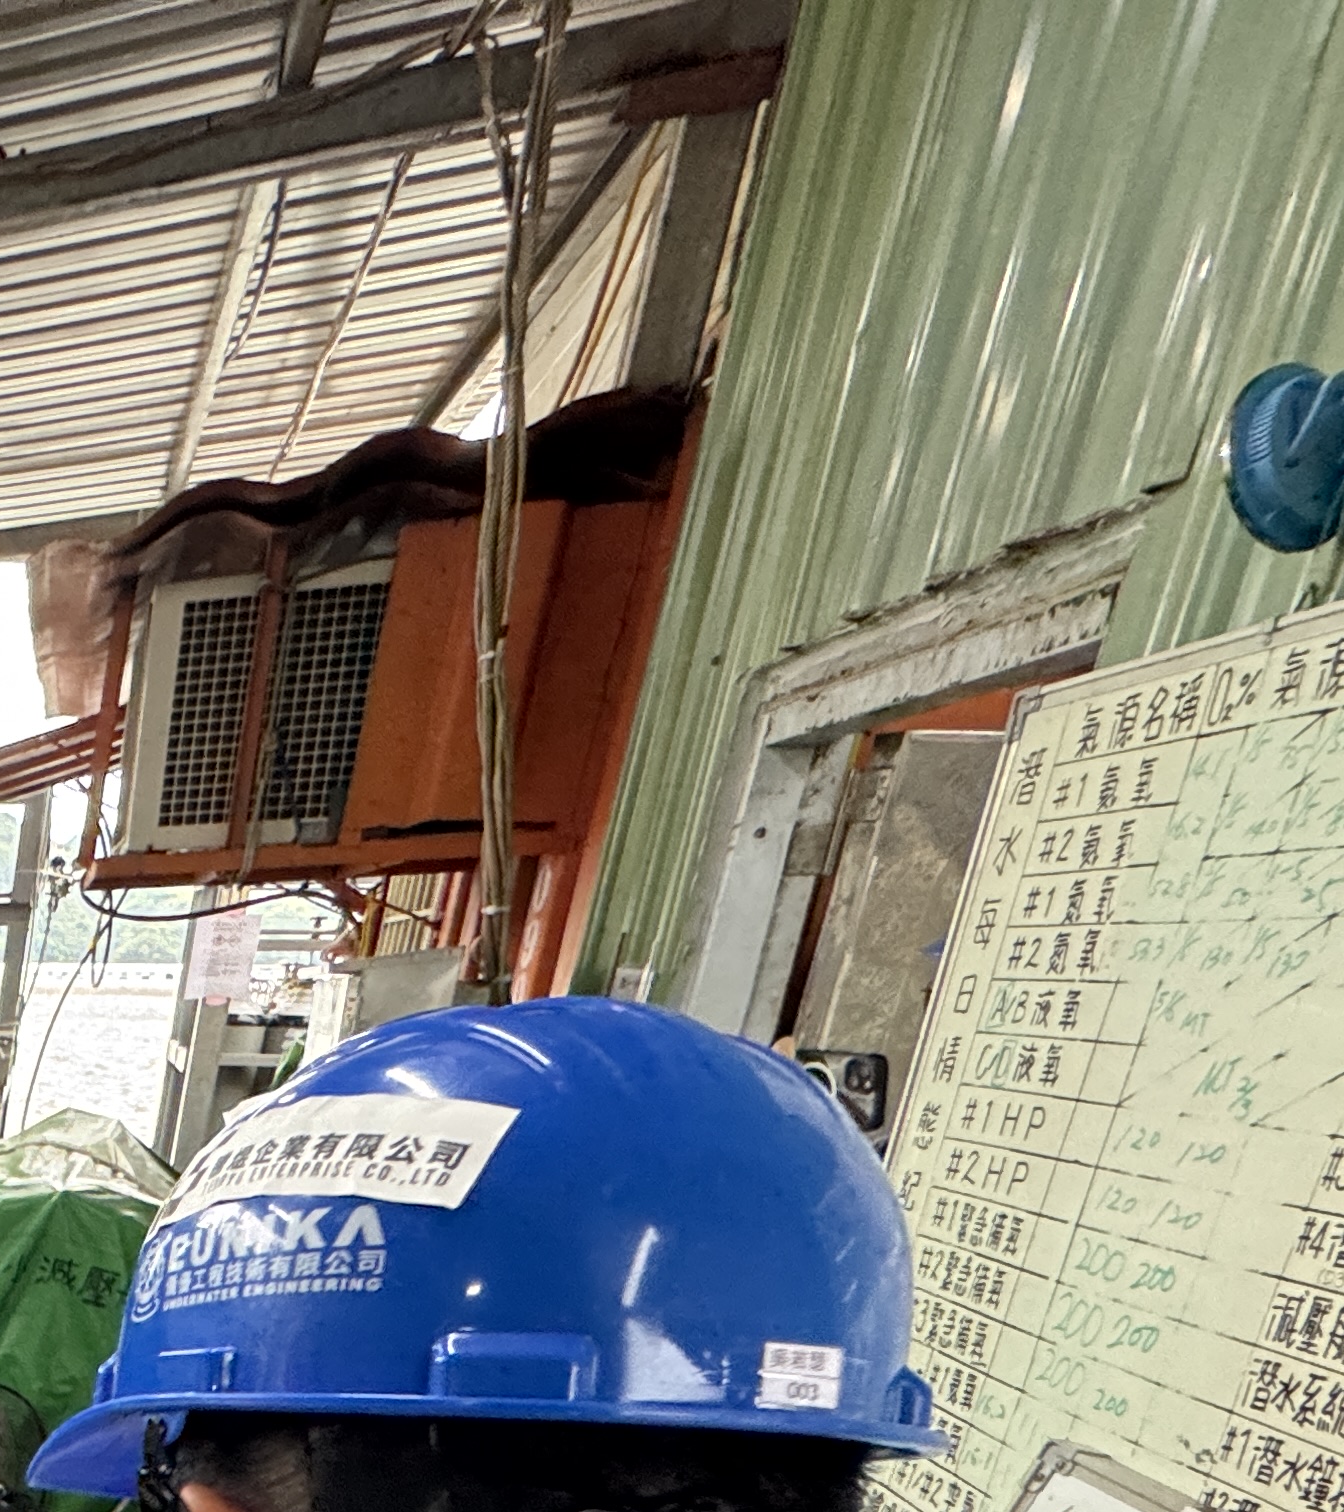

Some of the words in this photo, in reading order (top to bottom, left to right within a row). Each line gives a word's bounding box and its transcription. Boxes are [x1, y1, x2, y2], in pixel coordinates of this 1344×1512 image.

[1075, 1237, 1126, 1282] 200
[1052, 1292, 1104, 1348] 200
[1035, 1348, 1086, 1397] 200
